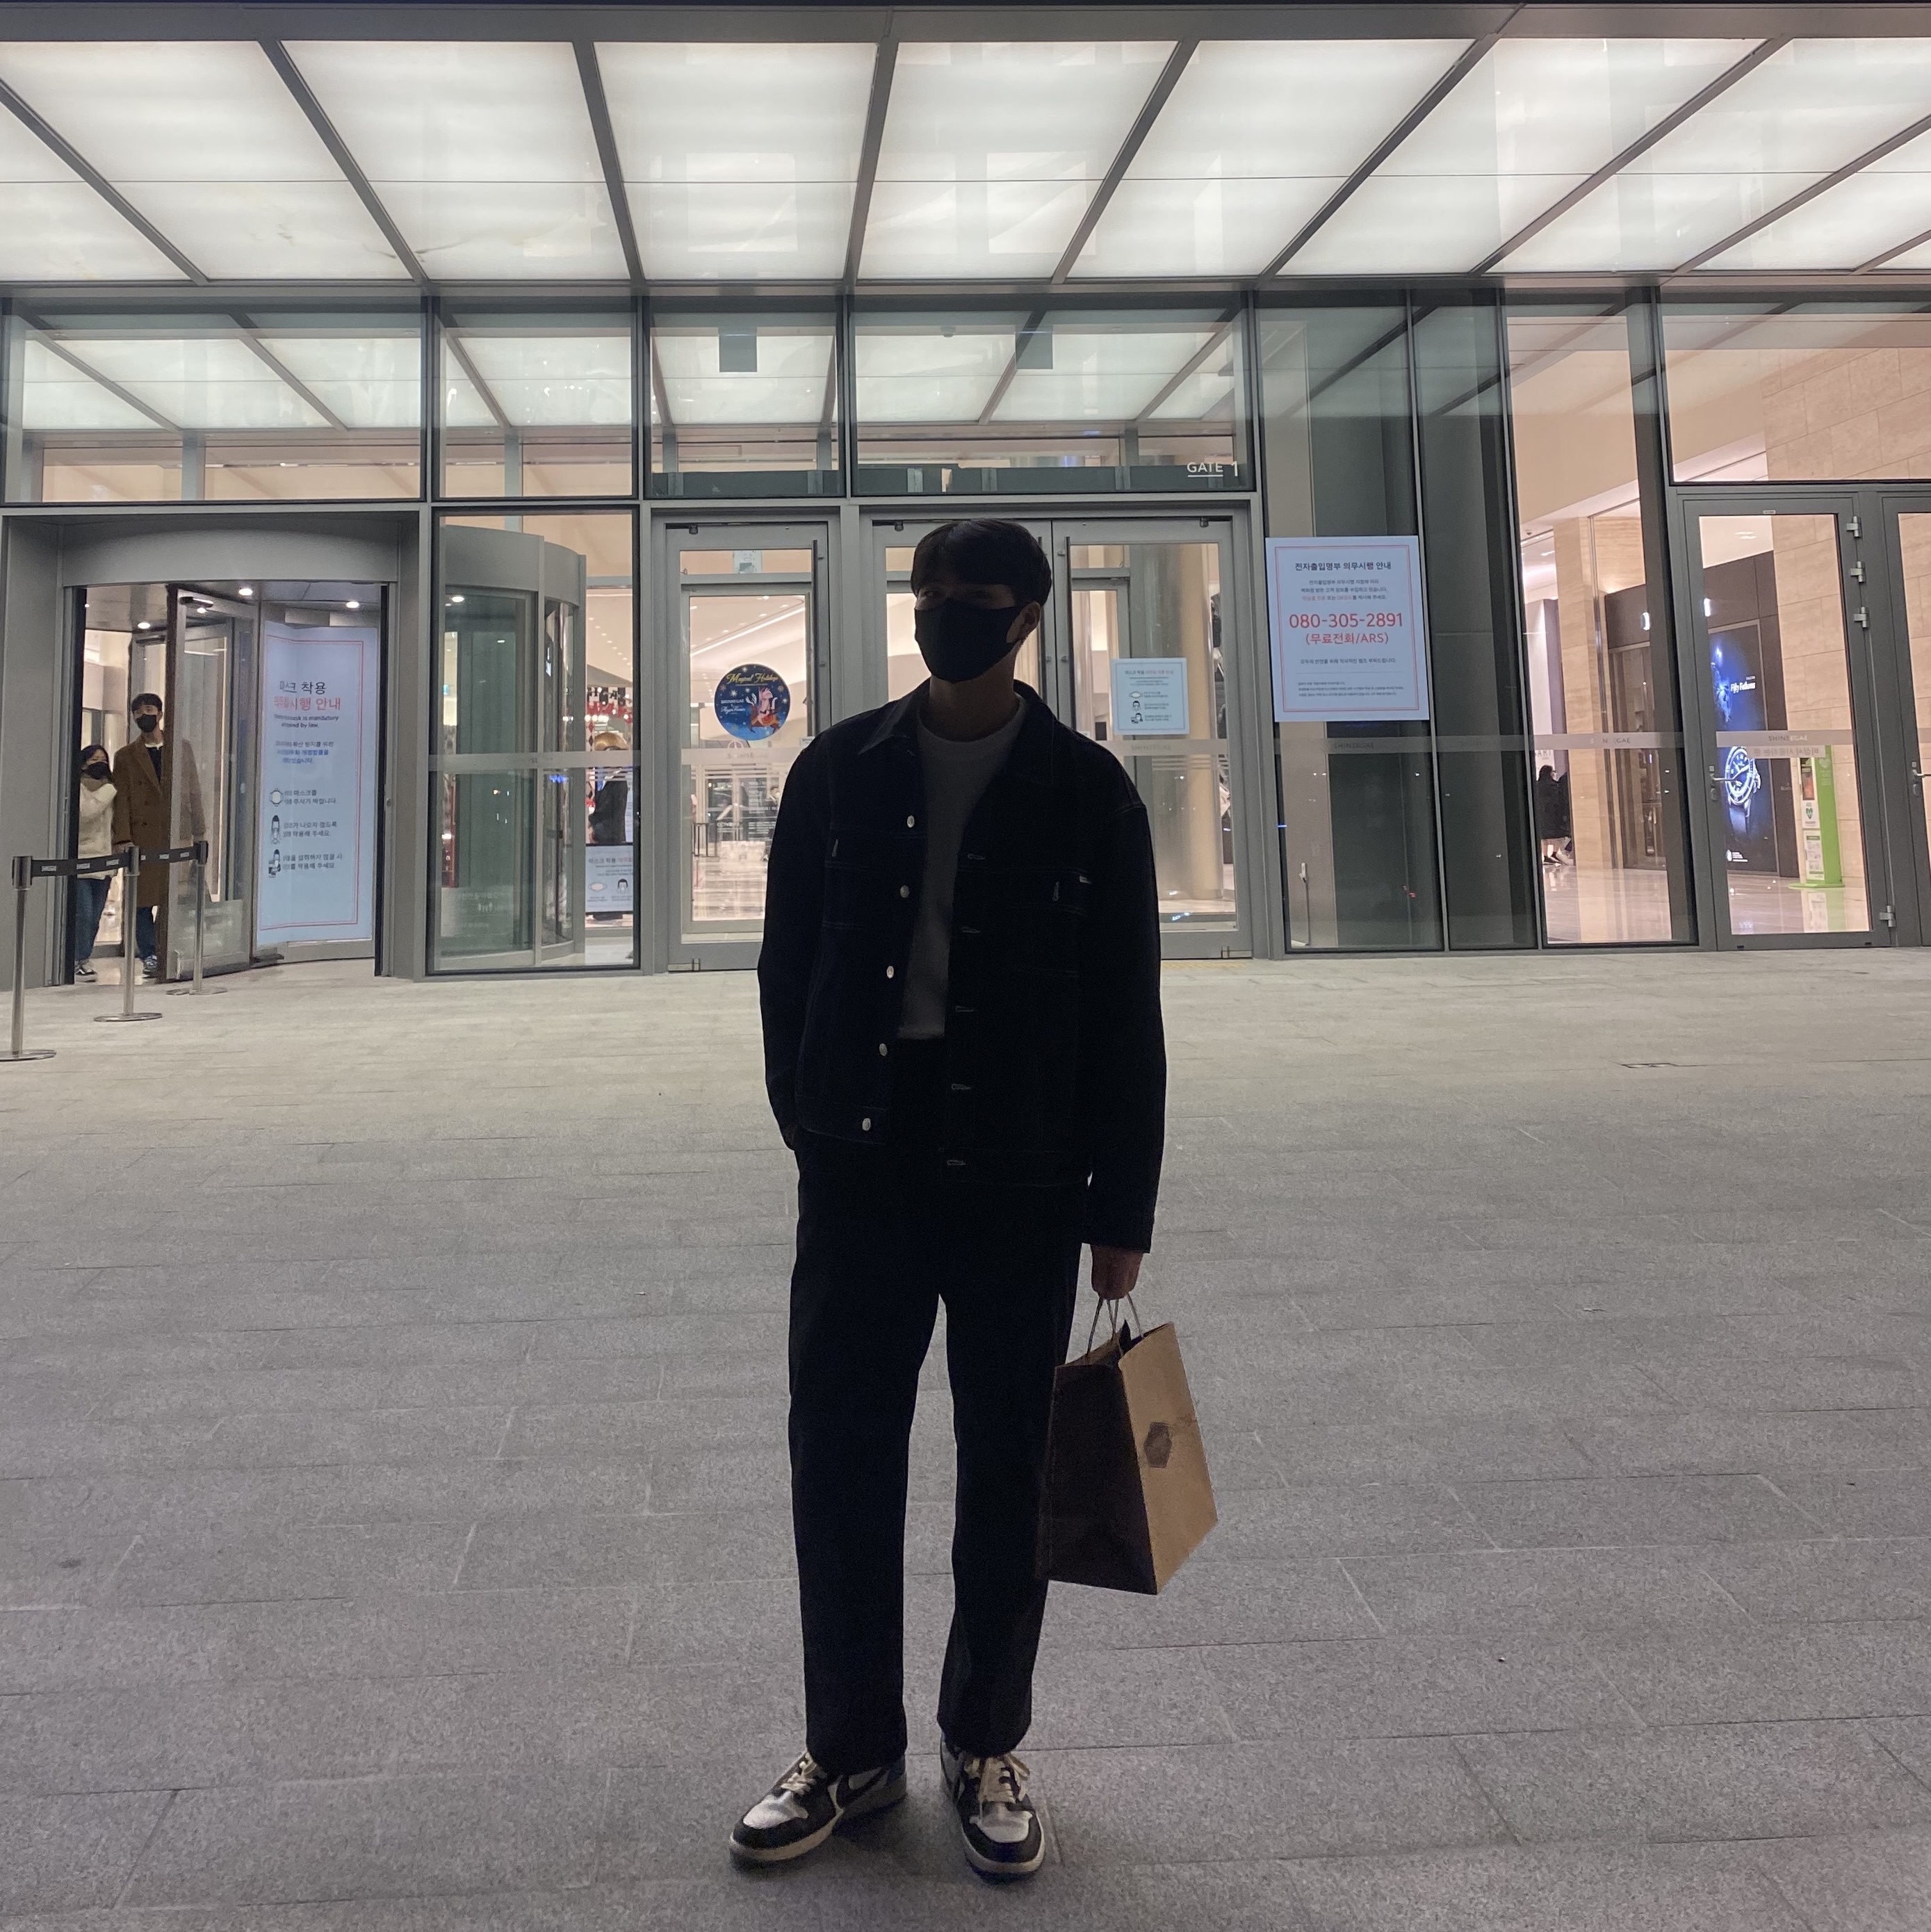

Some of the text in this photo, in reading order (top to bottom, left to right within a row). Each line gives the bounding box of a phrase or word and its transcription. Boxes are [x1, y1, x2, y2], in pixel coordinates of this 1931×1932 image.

[1187, 460, 1238, 477] GATE 1
[1295, 561, 1392, 571] 전자출입명부 의무시행 안내
[1289, 612, 1403, 628] 080-305-2891
[1305, 632, 1389, 645] (무료전화/ARS)
[302, 681, 327, 695] 착용
[316, 697, 341, 711] 안내
